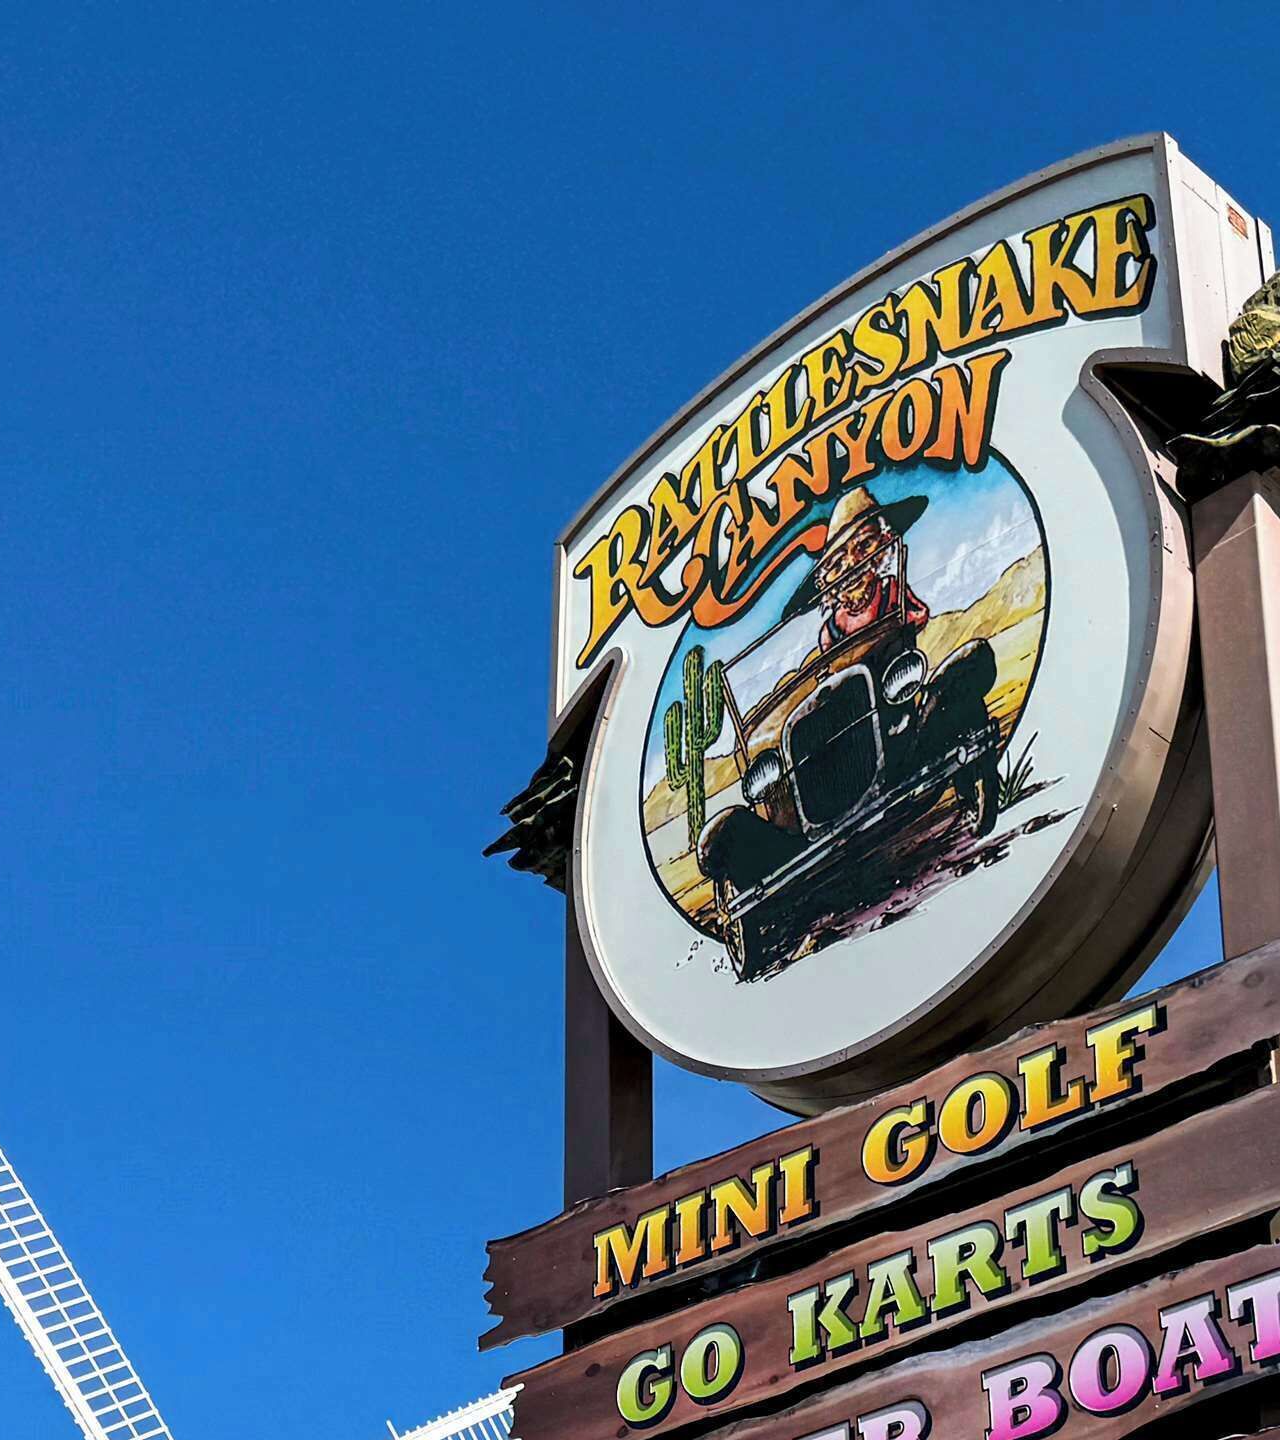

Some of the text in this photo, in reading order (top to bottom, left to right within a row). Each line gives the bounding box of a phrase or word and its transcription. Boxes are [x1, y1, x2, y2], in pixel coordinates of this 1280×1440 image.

[573, 193, 1157, 670] RATTLESNAKE
[676, 348, 1011, 629] CANYON
[591, 1001, 1166, 1300] MINI GOLF
[615, 1161, 1144, 1428] GO KARTS
